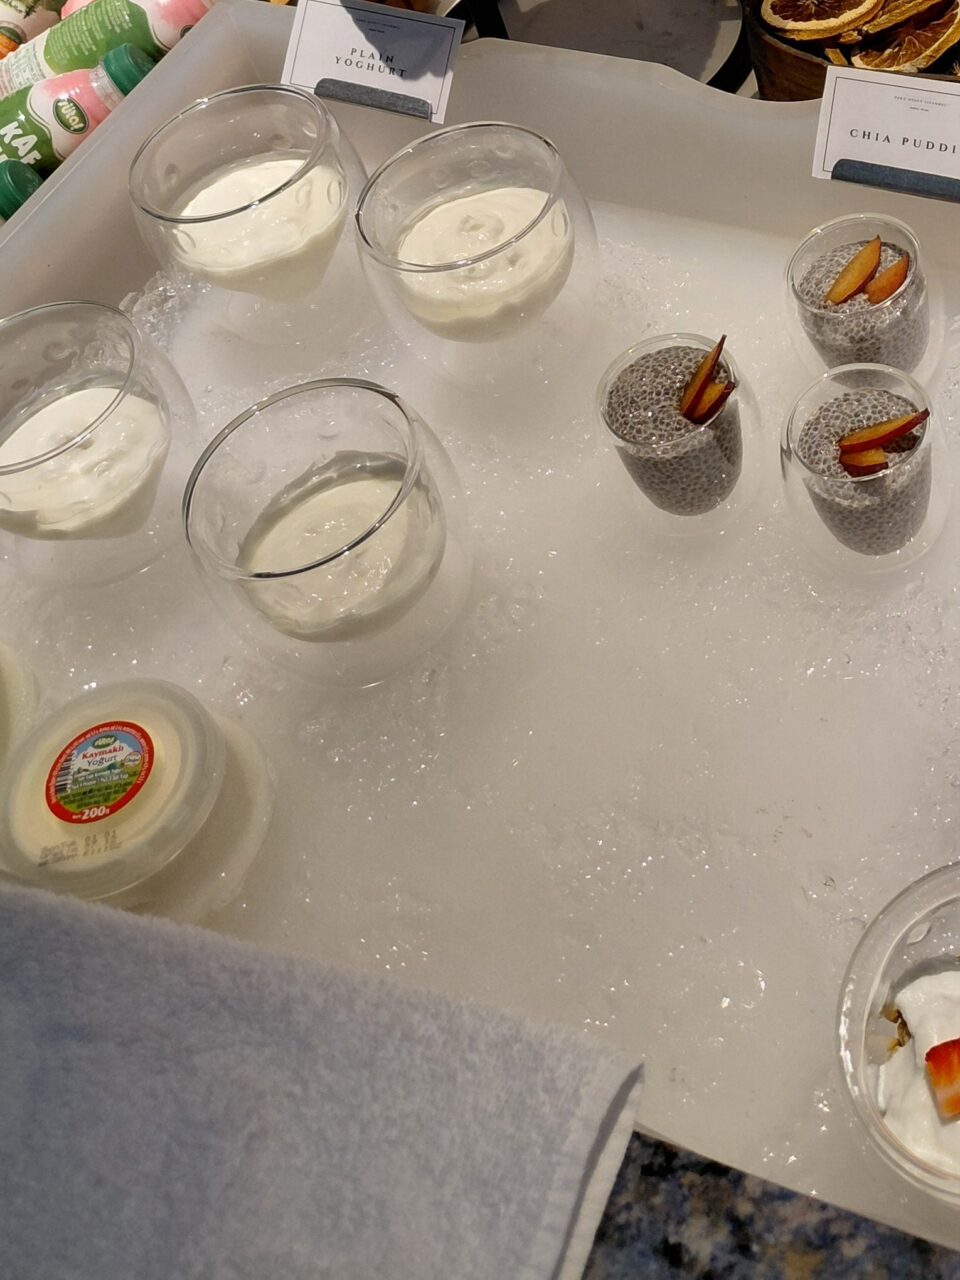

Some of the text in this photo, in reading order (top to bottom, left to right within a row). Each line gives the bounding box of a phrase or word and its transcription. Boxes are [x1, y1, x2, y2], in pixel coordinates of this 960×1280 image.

[350, 47, 394, 63] PLAIN
[335, 56, 407, 78] YOGHURT
[849, 128, 892, 144] CHIA
[82, 745, 124, 760] Kaymaklı
[87, 755, 118, 767] Yoğurt
